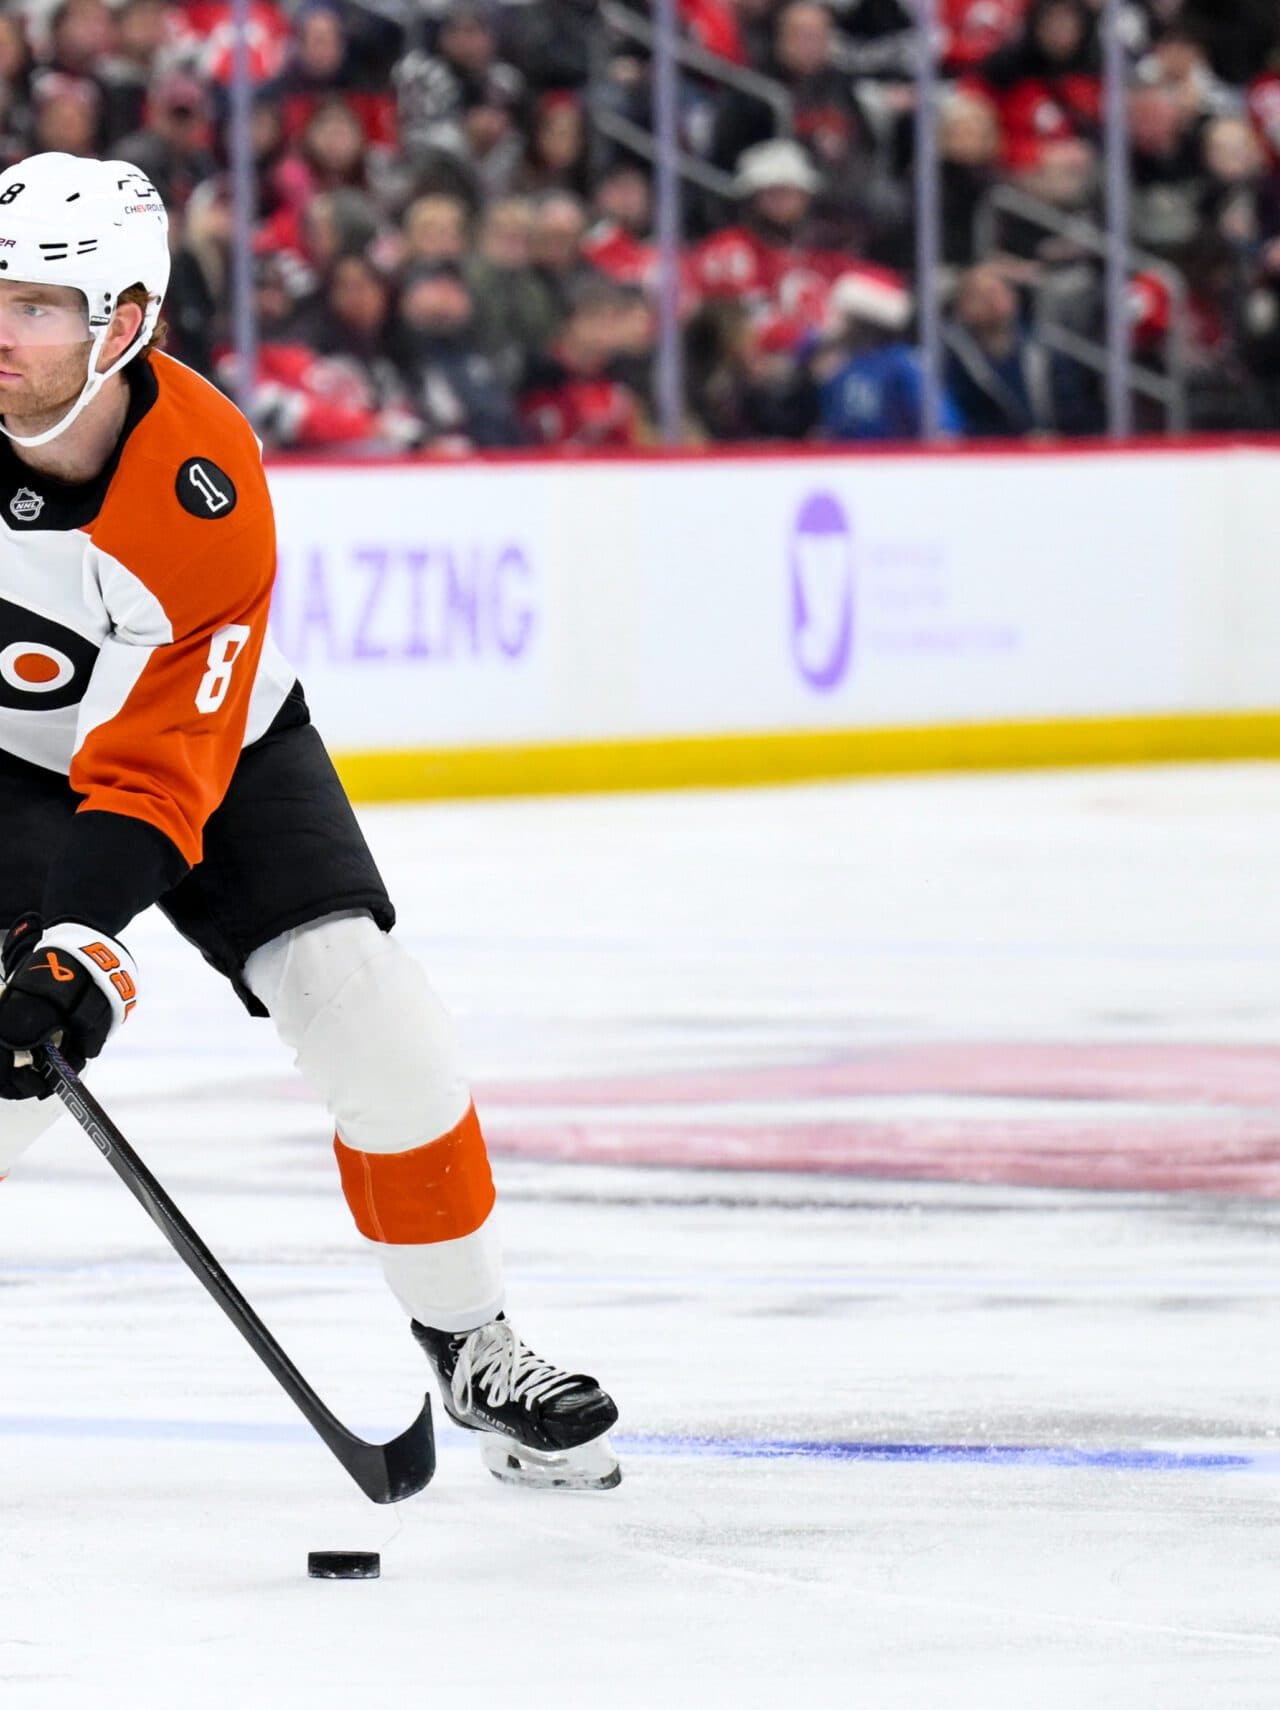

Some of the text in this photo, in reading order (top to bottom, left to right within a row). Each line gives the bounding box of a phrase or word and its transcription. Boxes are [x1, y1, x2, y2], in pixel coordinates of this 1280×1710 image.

[124, 203, 165, 215] CHEVROLE
[189, 463, 230, 512] 1
[194, 622, 251, 714] 8
